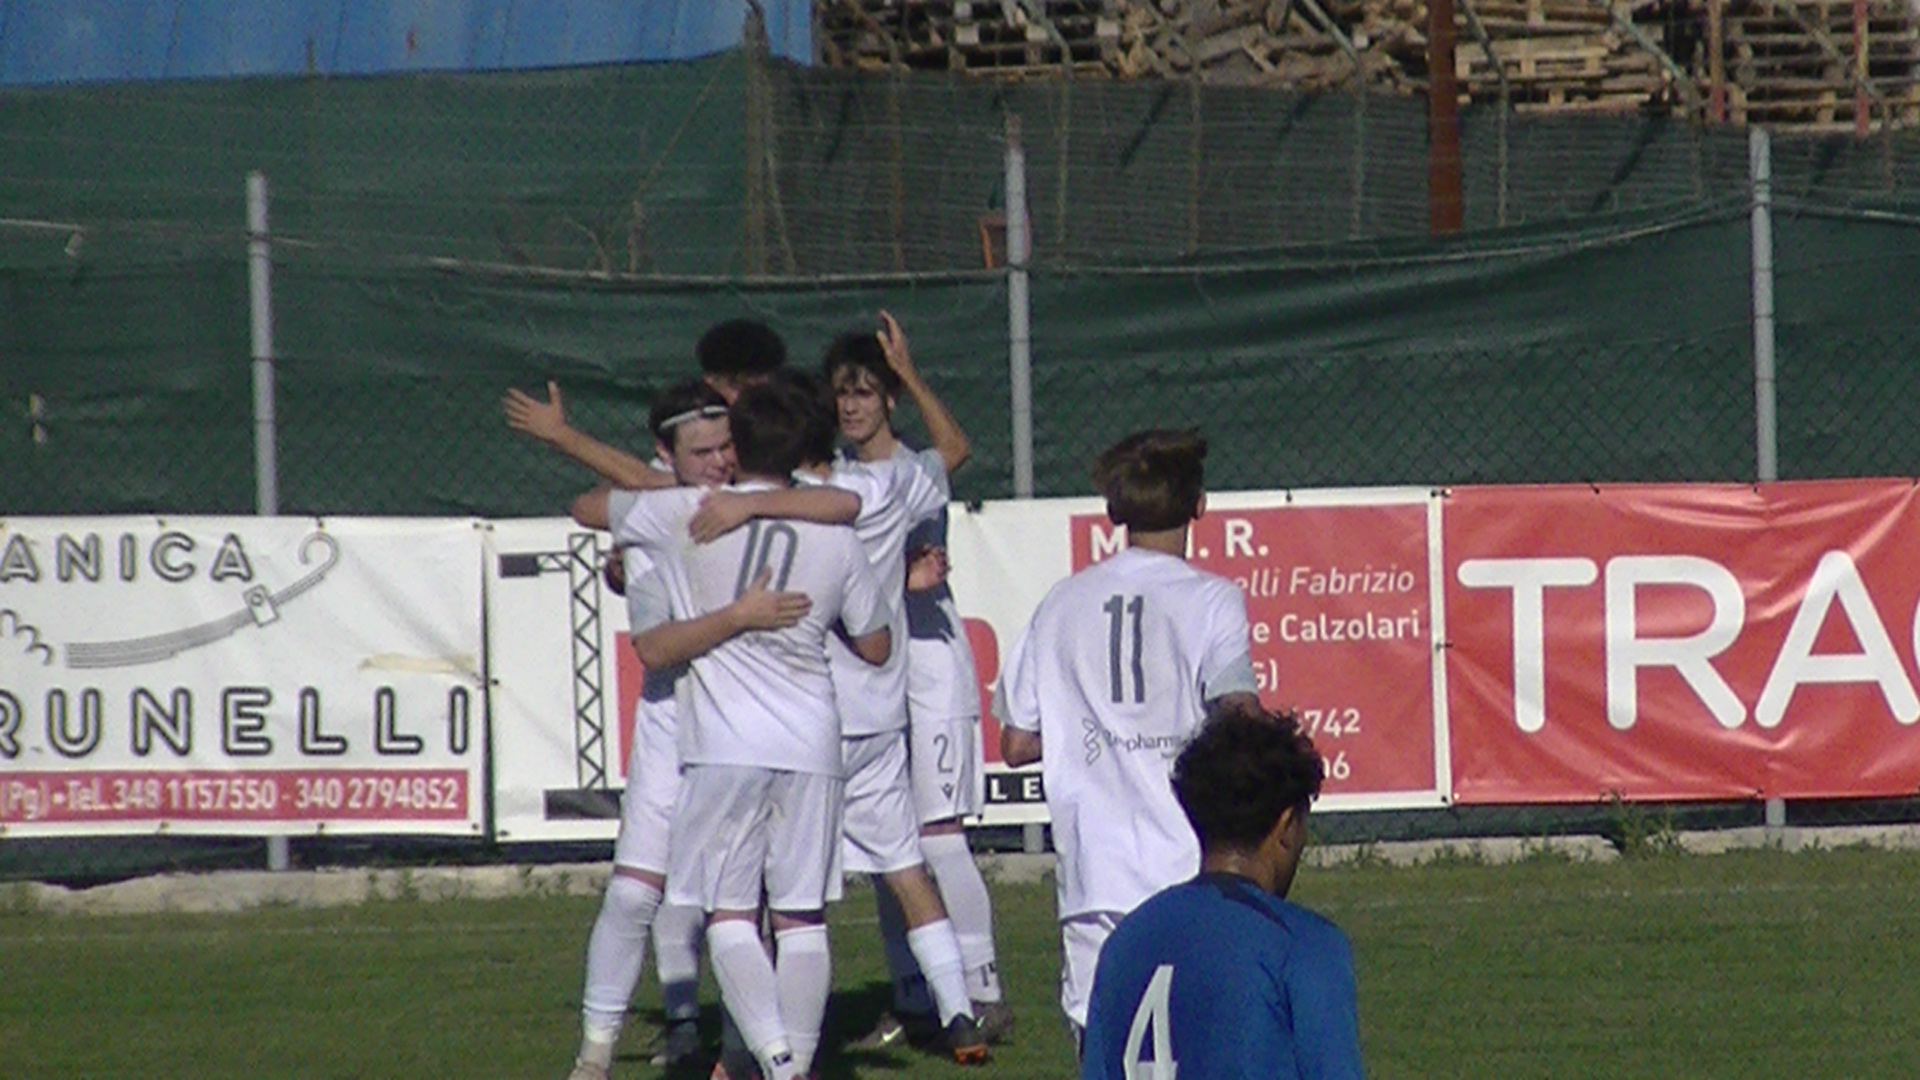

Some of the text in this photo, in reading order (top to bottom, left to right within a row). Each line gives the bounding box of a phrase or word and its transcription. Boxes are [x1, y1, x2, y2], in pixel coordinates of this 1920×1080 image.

[0, 533, 254, 582] ANICA
[734, 519, 798, 602] 10
[1289, 564, 1415, 596] Fabrizio
[1103, 595, 1145, 703] 11
[1279, 608, 1420, 642] Calzolari
[1457, 549, 1920, 732] TRA
[933, 733, 954, 773] 2
[113, 779, 160, 811] 348
[167, 779, 277, 810] 1157550
[295, 778, 344, 809] 340
[348, 778, 458, 809] 2794852
[1123, 964, 1178, 1080] 4
